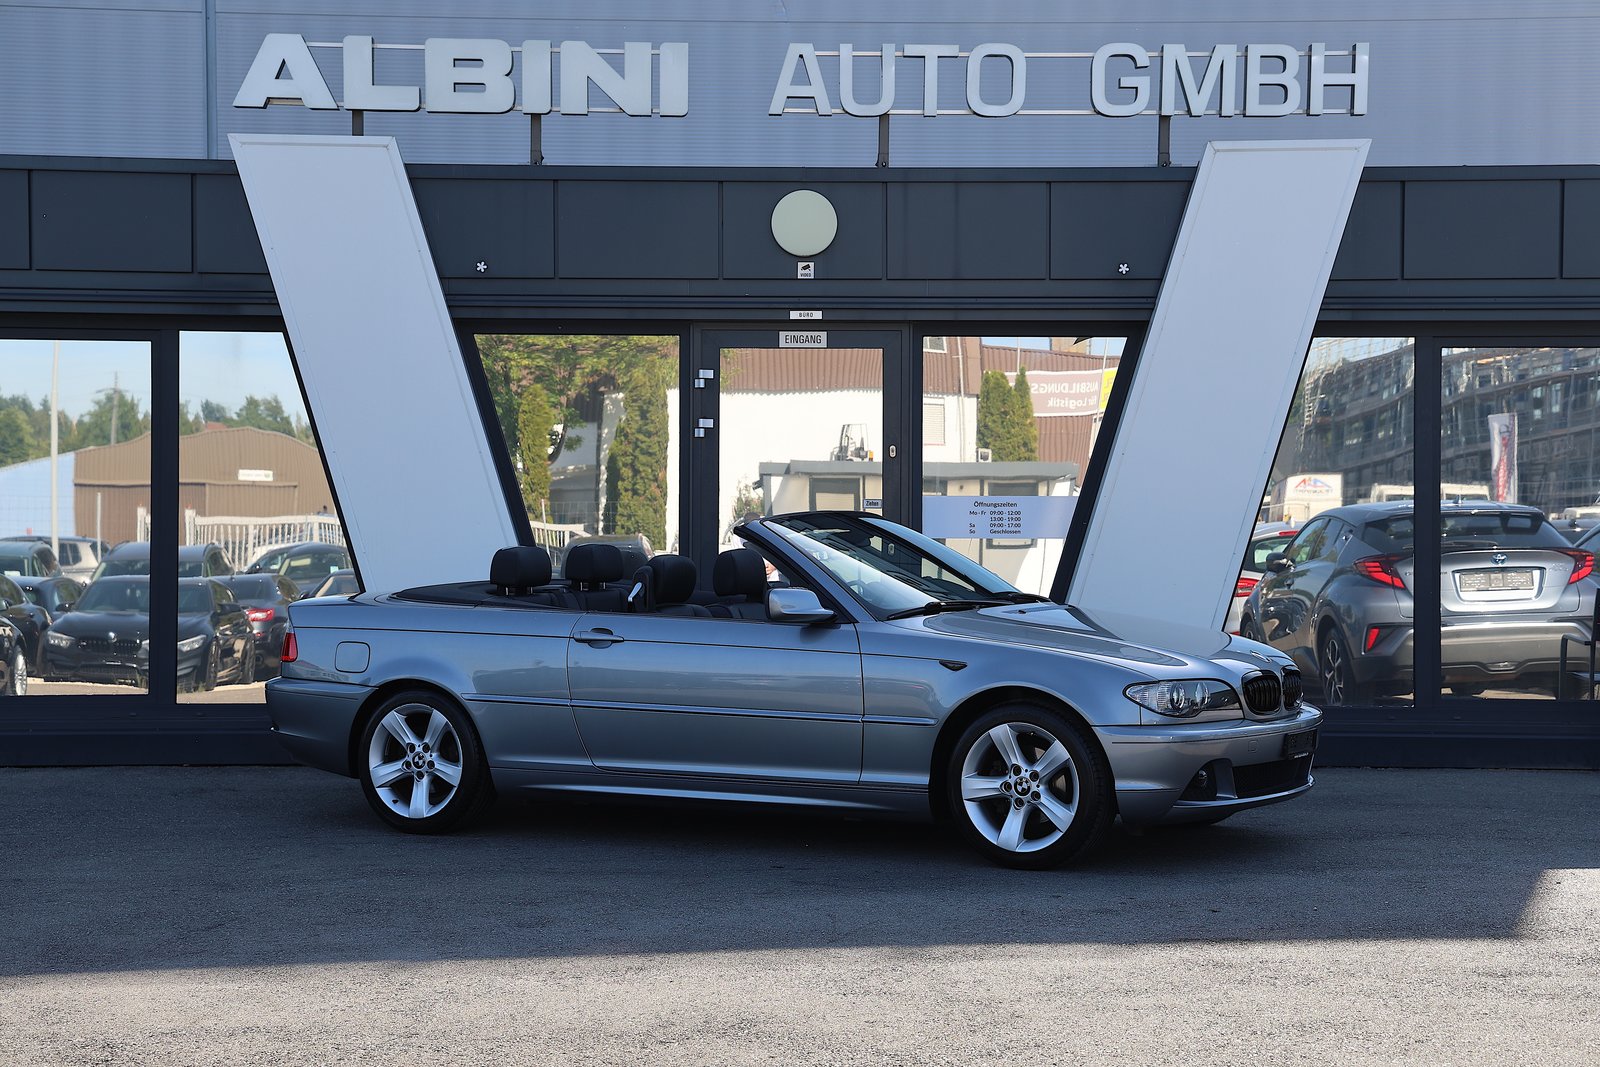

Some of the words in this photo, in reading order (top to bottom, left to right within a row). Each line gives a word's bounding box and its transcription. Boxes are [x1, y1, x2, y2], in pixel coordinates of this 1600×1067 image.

[232, 33, 689, 117] ALBINI
[768, 42, 1027, 118] AUTO
[1091, 42, 1370, 118] GMBH
[784, 334, 822, 344] EINGANG
